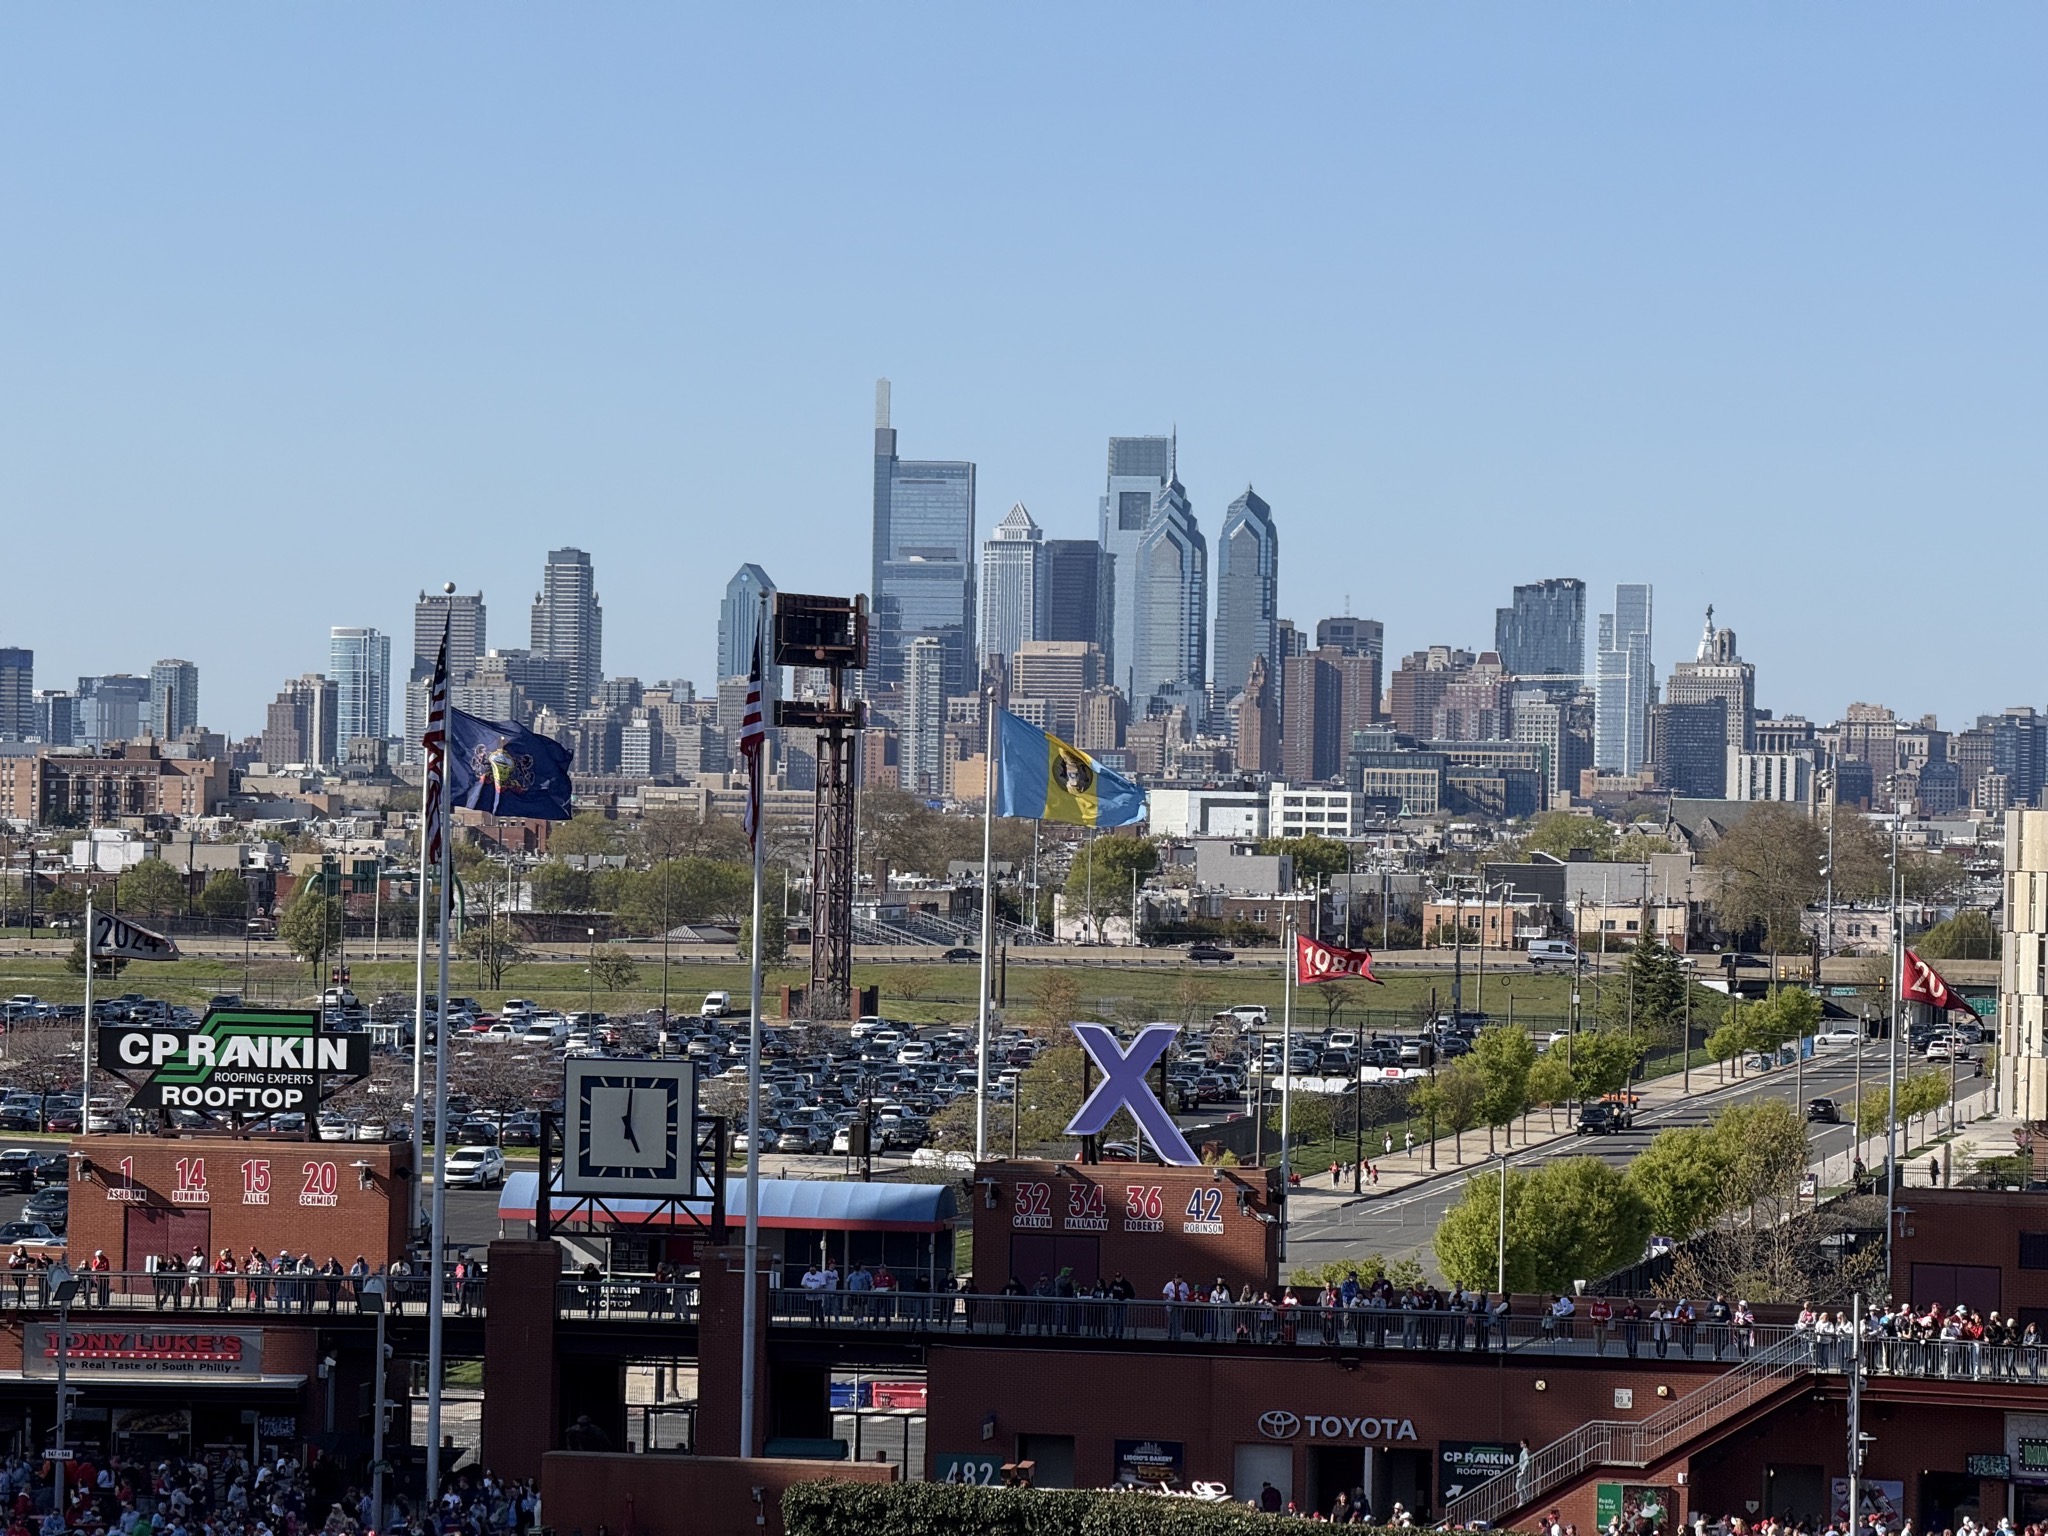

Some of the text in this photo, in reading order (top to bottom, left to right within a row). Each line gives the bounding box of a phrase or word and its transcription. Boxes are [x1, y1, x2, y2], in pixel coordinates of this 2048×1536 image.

[1562, 580, 1574, 589] W
[97, 917, 160, 953] 2024
[188, 1034, 347, 1070] RANKIN
[214, 1072, 314, 1085] ROOFING EXPERTS
[161, 1086, 303, 1108] ROOFTOP
[1062, 1022, 1203, 1166] X
[120, 1156, 133, 1188] 1
[176, 1158, 206, 1190] 14
[241, 1159, 271, 1193] 15
[302, 1161, 337, 1195] 20
[108, 1189, 147, 1200] ASHBURN
[172, 1191, 210, 1202] BUNNING
[243, 1193, 269, 1204] ALLEN
[300, 1194, 338, 1206] SCHMIDT
[1015, 1182, 1051, 1216] 32
[1068, 1184, 1106, 1218] 34
[1126, 1186, 1163, 1219] 36
[1186, 1187, 1223, 1222] 42
[1013, 1215, 1052, 1228] CARLTON
[1065, 1218, 1109, 1231] HALLADAY
[1124, 1219, 1164, 1232] ROBERTS
[1183, 1222, 1224, 1234] ROBINSON
[45, 1332, 242, 1353] TONY LUKE'S
[81, 1361, 106, 1369] Real
[112, 1361, 141, 1370] Taste
[146, 1362, 157, 1371] of
[161, 1362, 194, 1371] South
[199, 1363, 232, 1373] Philly
[1304, 1415, 1418, 1441] TOYOTA
[1464, 1452, 1515, 1465] RANKIN
[945, 1461, 994, 1485] 482
[1456, 1468, 1501, 1476] ROOFTOP
